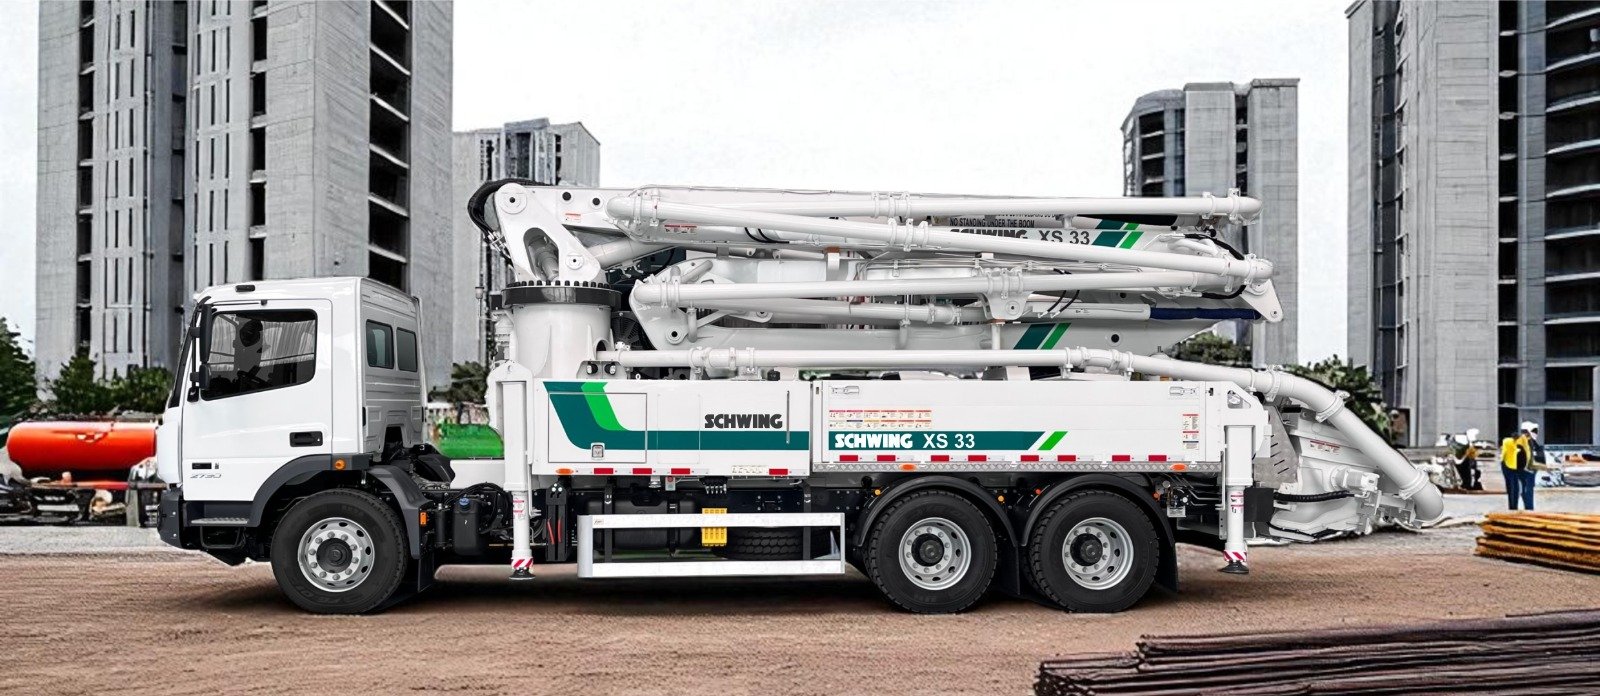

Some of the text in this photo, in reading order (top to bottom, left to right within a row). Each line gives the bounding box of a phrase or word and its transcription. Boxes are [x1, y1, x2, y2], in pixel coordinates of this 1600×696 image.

[949, 218, 1035, 228] NO STANDING UNDER THE BOOM
[1038, 230, 1063, 242] XS
[1069, 230, 1090, 245] 33
[704, 413, 783, 429] SCHWING
[834, 433, 976, 449] SCHWING XS 33
